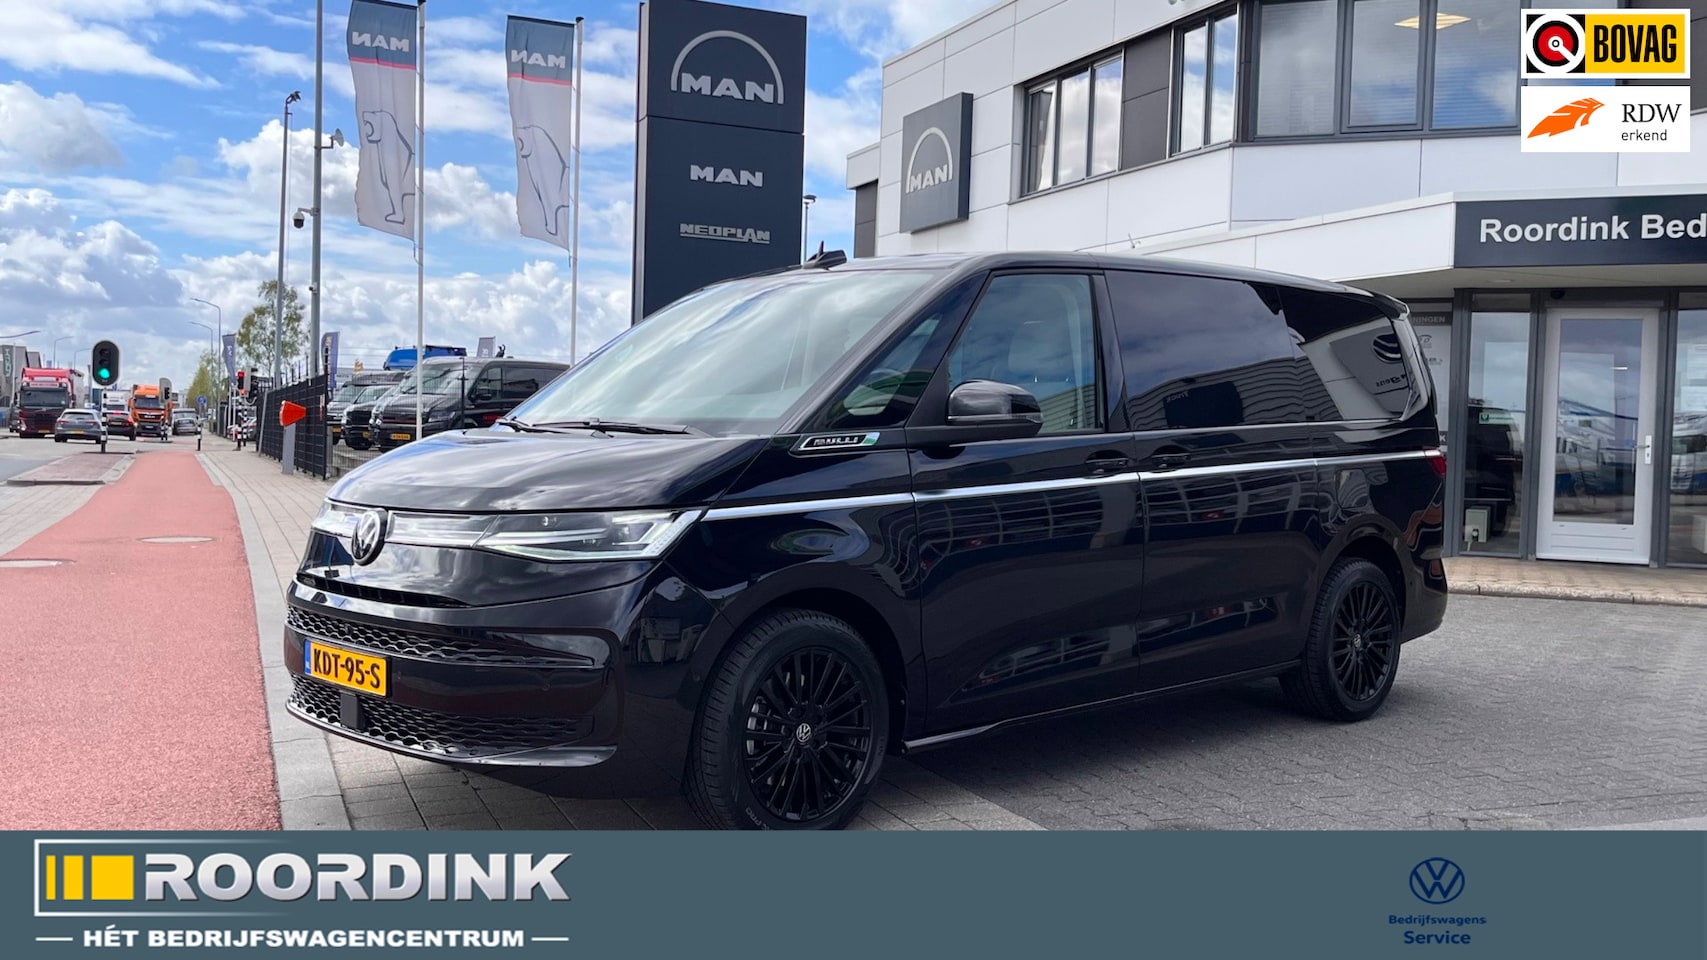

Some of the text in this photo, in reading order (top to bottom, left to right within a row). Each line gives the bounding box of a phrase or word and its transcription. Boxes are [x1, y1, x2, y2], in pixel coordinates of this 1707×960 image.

[681, 72, 774, 104] MAN
[690, 164, 764, 188] MAN
[910, 163, 948, 193] MAN
[679, 222, 771, 244] NEOPLAN
[1480, 213, 1707, 243] Roordink Bed
[1411, 315, 1446, 323] NINGEN
[313, 648, 381, 689] KDT-95-S
